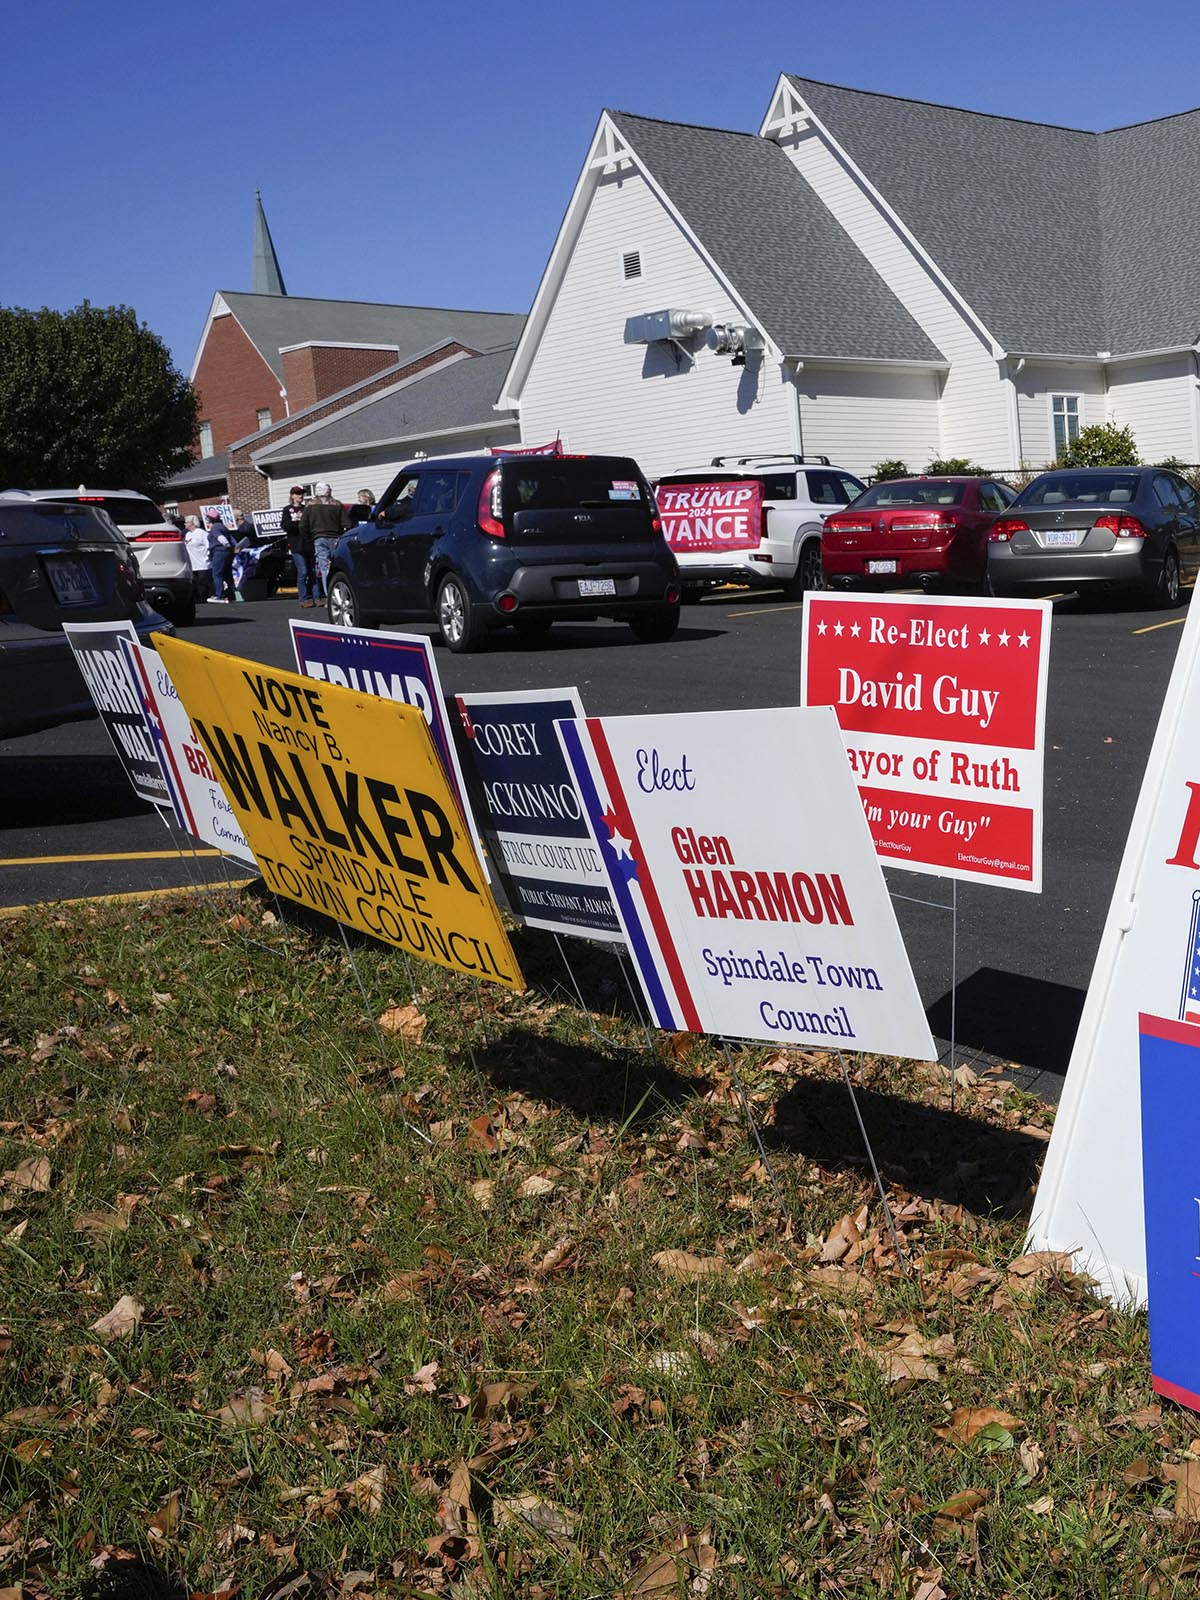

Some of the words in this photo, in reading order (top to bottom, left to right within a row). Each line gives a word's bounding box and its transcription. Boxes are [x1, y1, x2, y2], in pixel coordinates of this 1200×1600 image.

[664, 488, 753, 509] TRUMP
[688, 508, 712, 517] 2024
[261, 522, 281, 530] WALZ
[661, 516, 749, 541] VANCE
[868, 616, 969, 649] Re-Elect
[74, 650, 141, 715] HARRI
[156, 670, 179, 700] Ele
[242, 671, 330, 729] VOTE
[837, 667, 922, 711] David
[933, 675, 1000, 728] Guy
[252, 710, 318, 761] Nancy
[323, 733, 350, 764] B.
[473, 722, 542, 756] COREY
[636, 748, 696, 793] Elect
[847, 748, 903, 779] ayor
[913, 749, 941, 782] of
[950, 752, 1020, 792] Ruth
[193, 718, 480, 895] WALKER
[482, 781, 581, 820] ACKINNO
[863, 799, 882, 822] 'm
[887, 809, 931, 830] your
[938, 810, 991, 842] Guy"
[536, 843, 575, 871] COURT
[575, 848, 601, 878] JUD
[671, 826, 735, 865] Glen
[878, 839, 912, 853] ElectYourGuy
[957, 852, 1030, 872] ElectYourGuy@gmail.com
[289, 834, 432, 919] SPINDALE
[518, 886, 549, 905] PUBLIC
[682, 869, 855, 926] HARMON
[256, 853, 353, 921] TOWN
[357, 897, 513, 982] COUNCIL
[702, 948, 807, 986] Spindale
[806, 956, 883, 991] Town
[760, 1001, 856, 1038] Council
